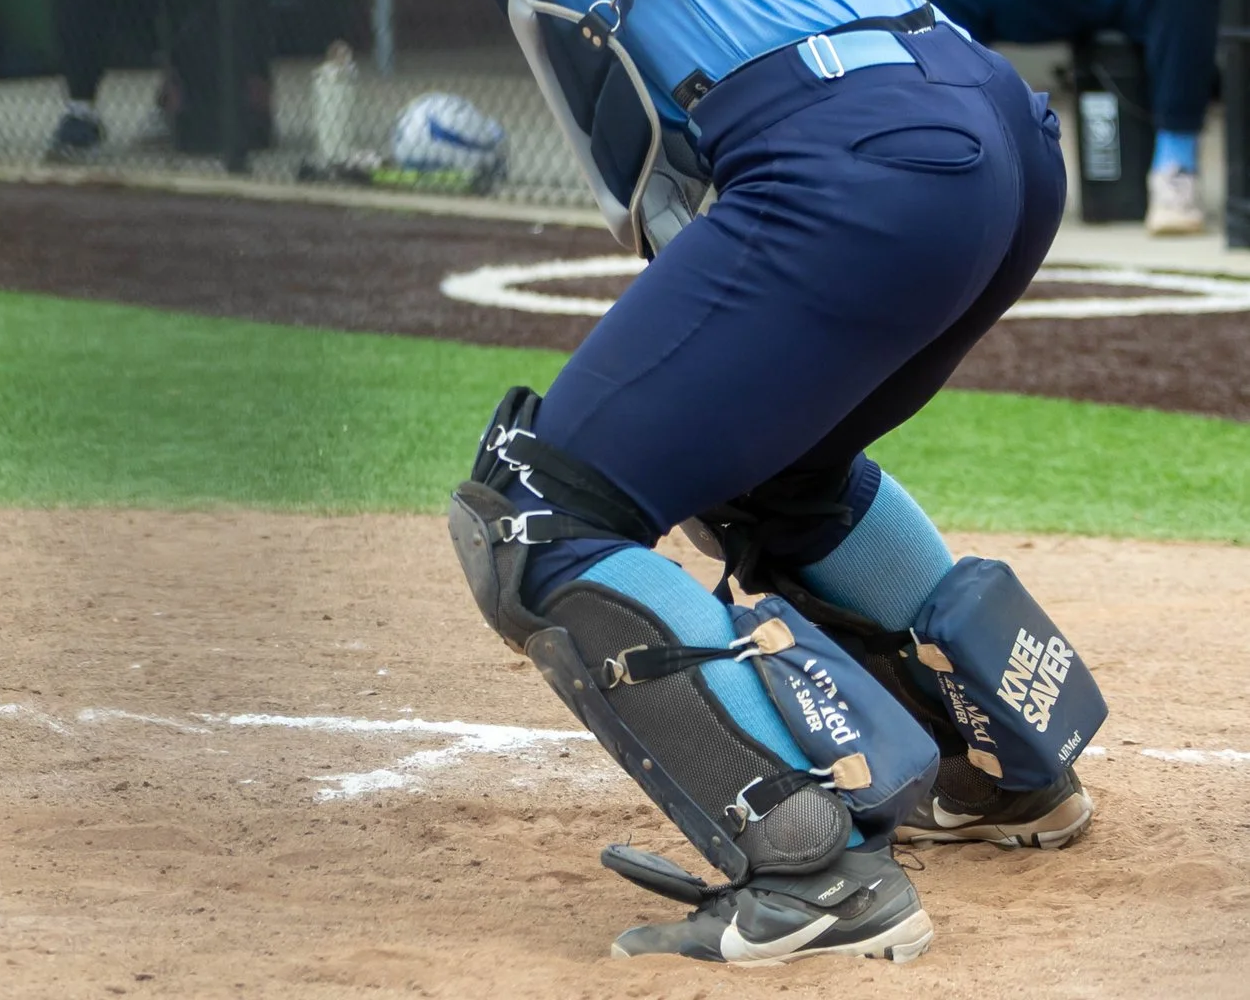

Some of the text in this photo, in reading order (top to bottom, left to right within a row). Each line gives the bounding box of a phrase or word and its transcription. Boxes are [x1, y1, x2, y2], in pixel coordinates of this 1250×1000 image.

[996, 627, 1045, 713] KNEE
[1023, 635, 1074, 733] SAVER
[795, 688, 823, 733] SAVER
[949, 692, 969, 725] SAVER
[1057, 729, 1082, 764] AliMed
[817, 880, 845, 901] TROUT
